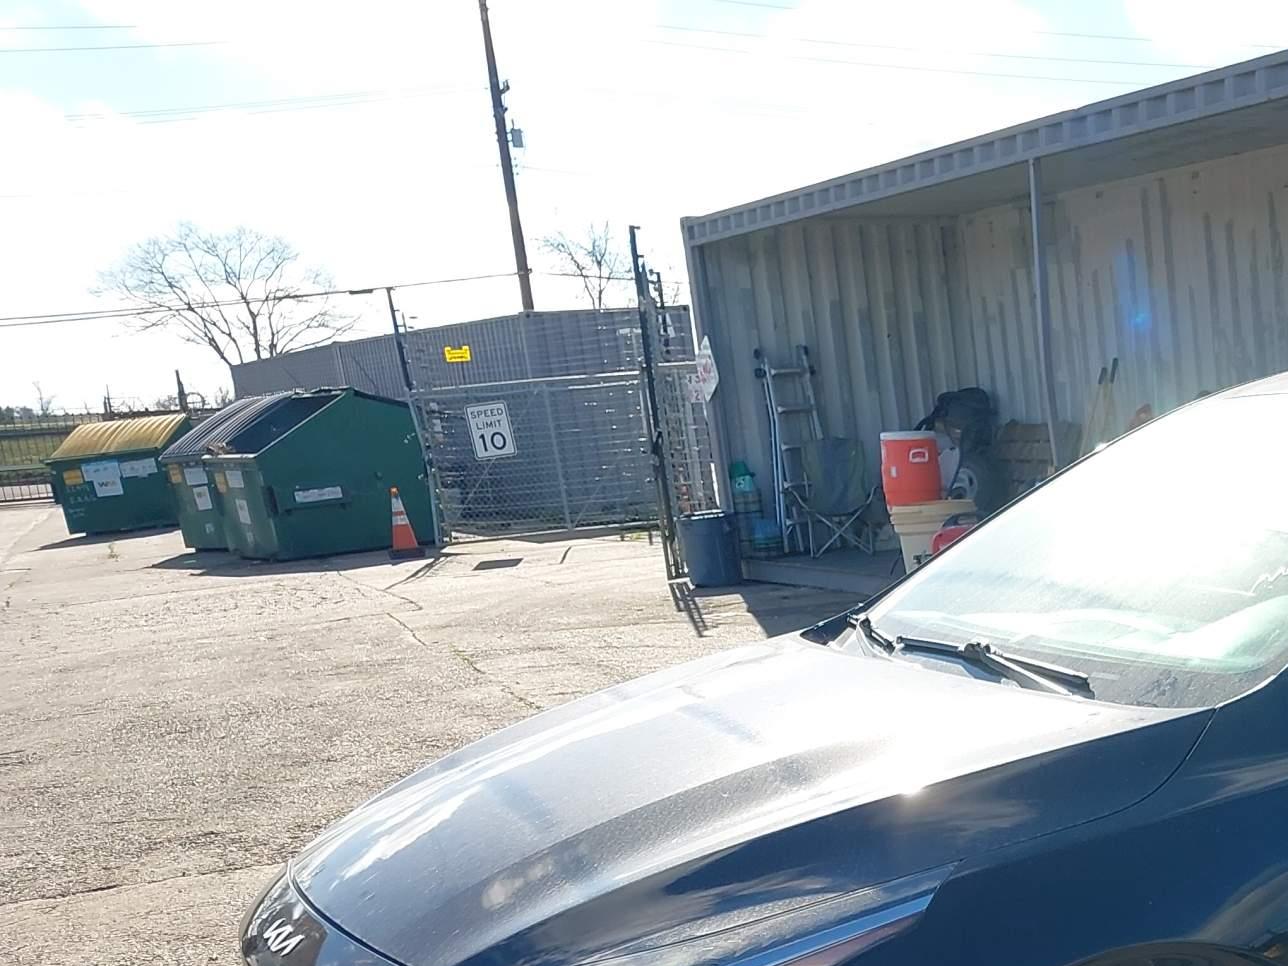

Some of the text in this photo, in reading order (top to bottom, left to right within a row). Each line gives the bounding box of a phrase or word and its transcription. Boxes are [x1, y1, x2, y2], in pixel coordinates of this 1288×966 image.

[470, 407, 504, 420] SPEED
[475, 419, 503, 431] LIMIT
[478, 431, 507, 452] 10
[262, 917, 305, 957] KIA
